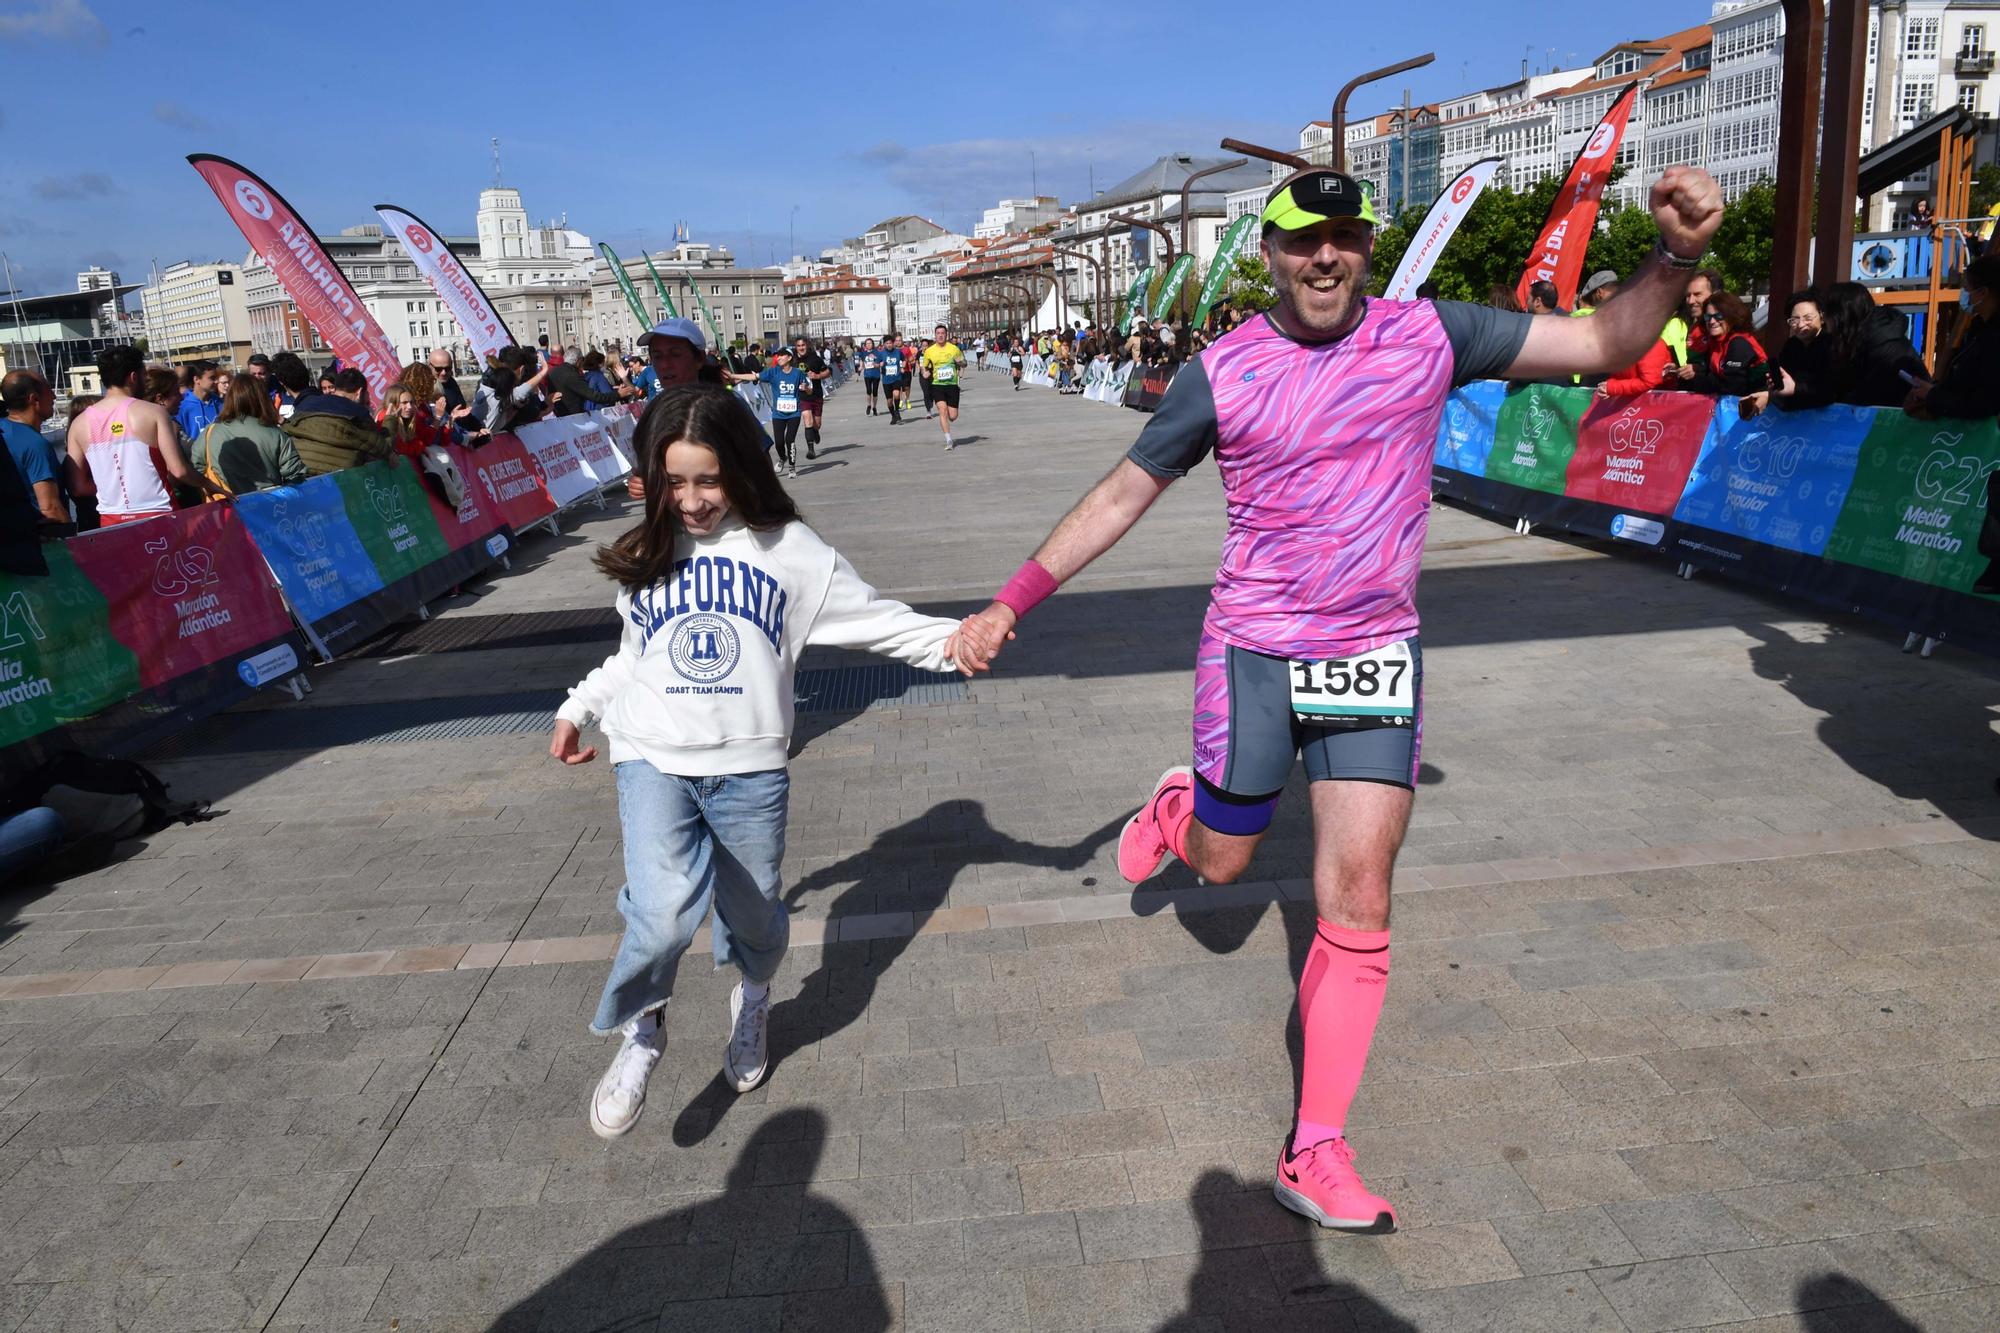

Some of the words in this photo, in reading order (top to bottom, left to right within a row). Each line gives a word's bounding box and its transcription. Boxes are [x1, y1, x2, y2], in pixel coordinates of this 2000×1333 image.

[1411, 211, 1451, 274] DEPORTE
[1606, 455, 1643, 470] Maratón
[1903, 505, 1951, 528] Media
[1895, 525, 1962, 553] Maratón
[174, 592, 220, 619] Maratón
[178, 608, 232, 640] Atlántica
[691, 634, 719, 659] LA
[714, 686, 743, 695] CAMPUS
[1294, 660, 1407, 696] 1587
